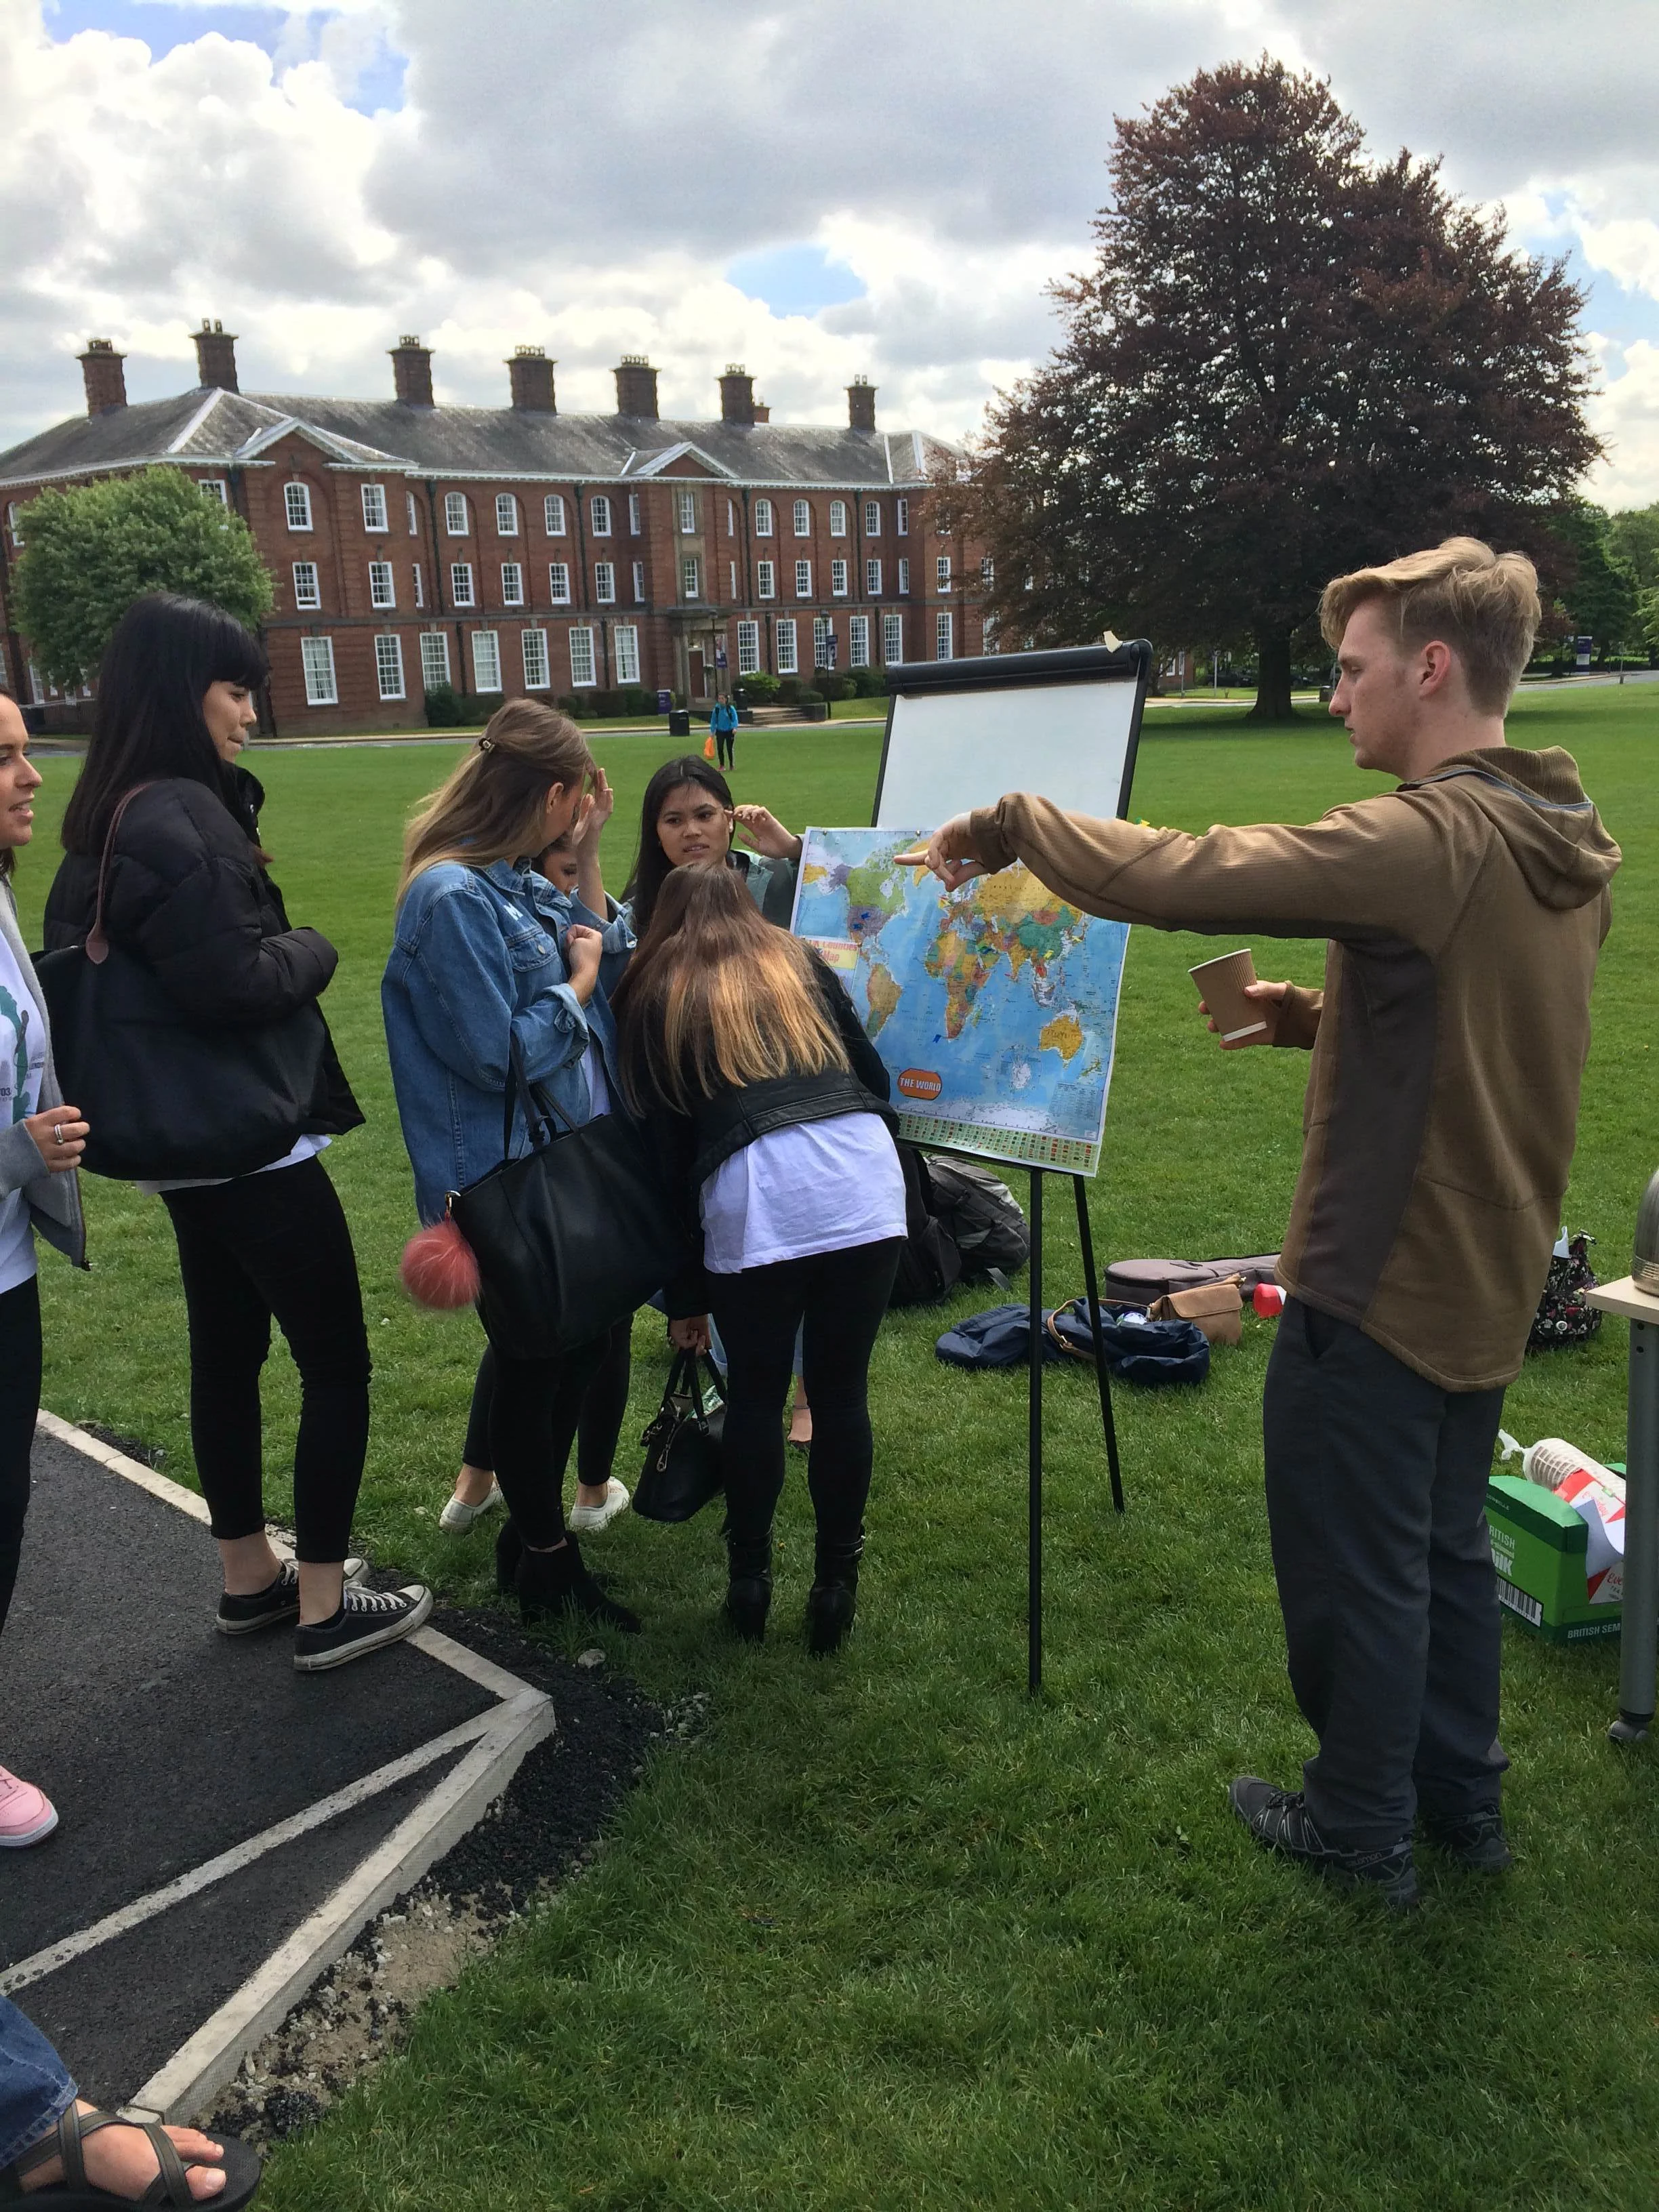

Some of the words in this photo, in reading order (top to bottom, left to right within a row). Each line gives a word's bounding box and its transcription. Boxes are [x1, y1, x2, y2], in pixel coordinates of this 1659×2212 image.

[900, 1078, 915, 1088] THE
[916, 1080, 941, 1092] WORLD
[1488, 1524, 1515, 1550] RITISH
[1607, 1572, 1622, 1586] Eve
[1567, 1626, 1600, 1639] BRITISH
[1601, 1622, 1621, 1634] SEM
